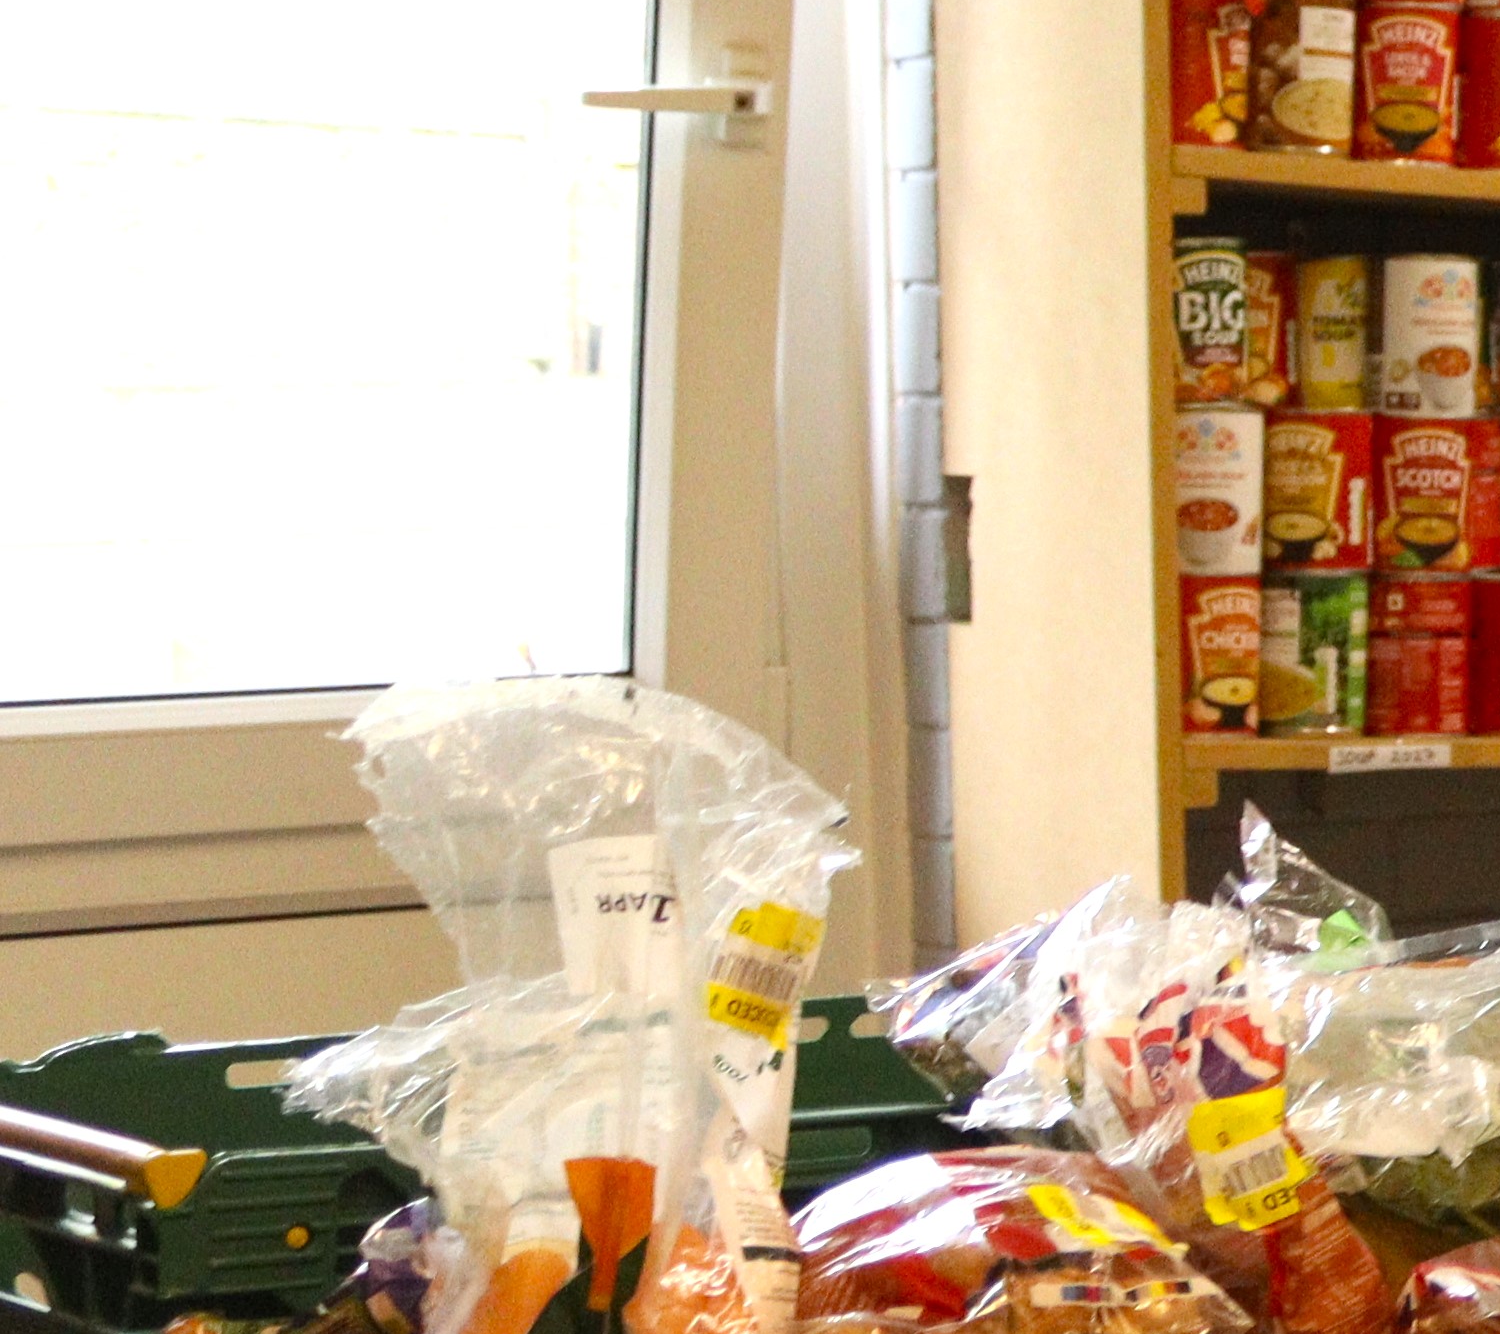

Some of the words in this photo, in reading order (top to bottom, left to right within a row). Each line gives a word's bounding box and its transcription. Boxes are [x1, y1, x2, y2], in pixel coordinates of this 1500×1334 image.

[1380, 23, 1440, 49] HEINZ
[1183, 261, 1240, 285] HEINZ
[1178, 289, 1246, 331] BIG
[1403, 436, 1460, 461] HEINZ
[596, 893, 651, 916] APR
